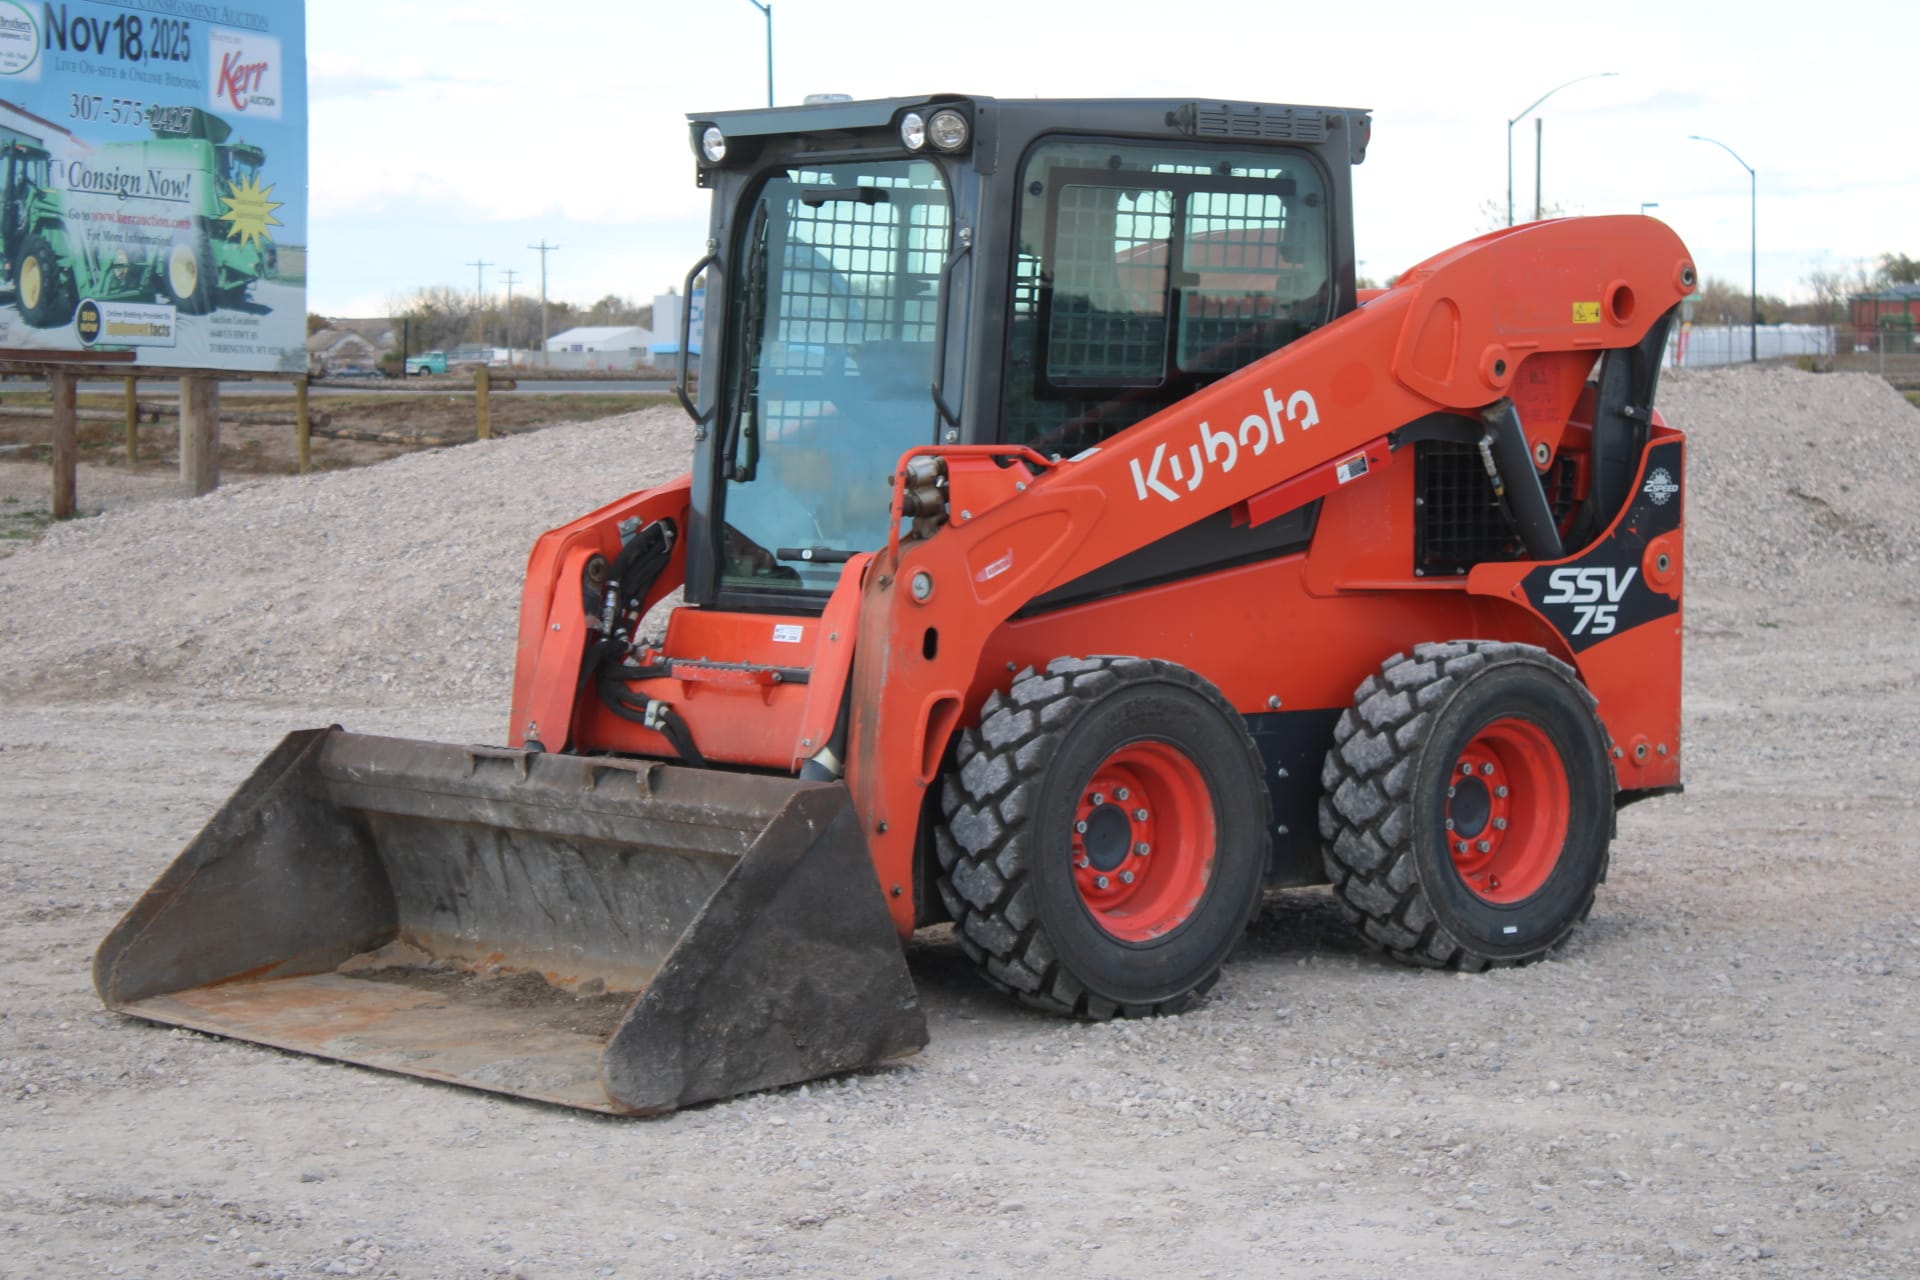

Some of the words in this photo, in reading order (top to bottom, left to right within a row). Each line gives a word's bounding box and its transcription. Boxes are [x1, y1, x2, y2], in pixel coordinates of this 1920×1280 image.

[44, 1, 111, 55] Nov
[150, 17, 190, 62] 2025
[222, 6, 269, 29] AUCTION
[55, 56, 77, 73] LIVE
[217, 50, 268, 111] Kerr
[69, 93, 194, 133] 307-575-2427
[249, 95, 276, 107] AUCTION
[68, 161, 141, 200] Consign
[145, 169, 192, 199] Now!
[1129, 387, 1320, 502] Kubota
[1543, 567, 1638, 604] SSV
[1571, 605, 1619, 635] 75
